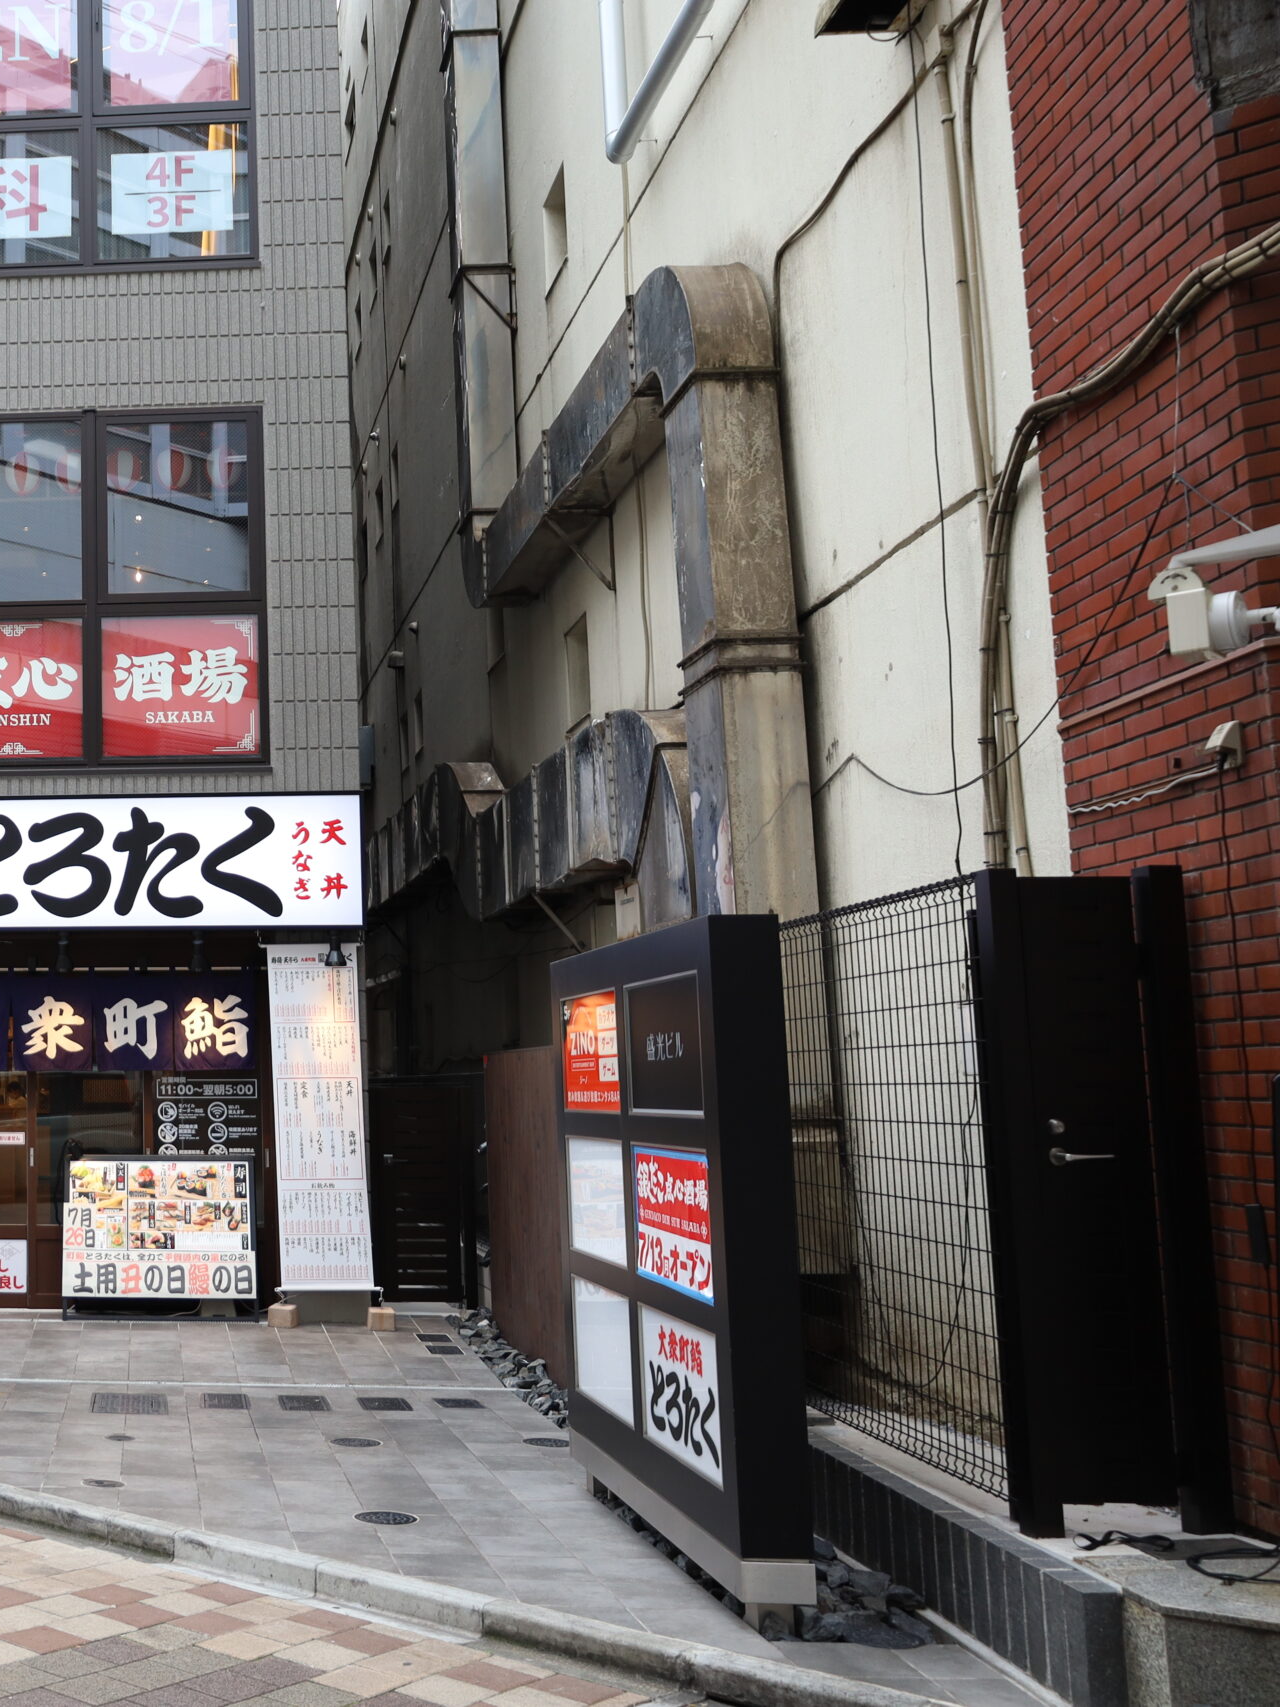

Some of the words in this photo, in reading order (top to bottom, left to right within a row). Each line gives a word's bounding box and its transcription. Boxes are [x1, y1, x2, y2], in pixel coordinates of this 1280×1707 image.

[146, 155, 196, 188] 4F
[146, 195, 196, 228] 3F
[113, 646, 248, 705] 酒場
[145, 711, 215, 724] SAKABA
[291, 820, 313, 900] うなぎ
[320, 818, 348, 900] 天丼
[570, 1030, 595, 1056] ZINO
[637, 1156, 709, 1211] 銀だこ点心酒場
[68, 1208, 91, 1228] 7月
[65, 1227, 95, 1248] 26日
[73, 1262, 253, 1295] 土用丑の日鰻の日
[658, 1325, 703, 1378] 大衆町鮨
[649, 1360, 720, 1469] とろたく
